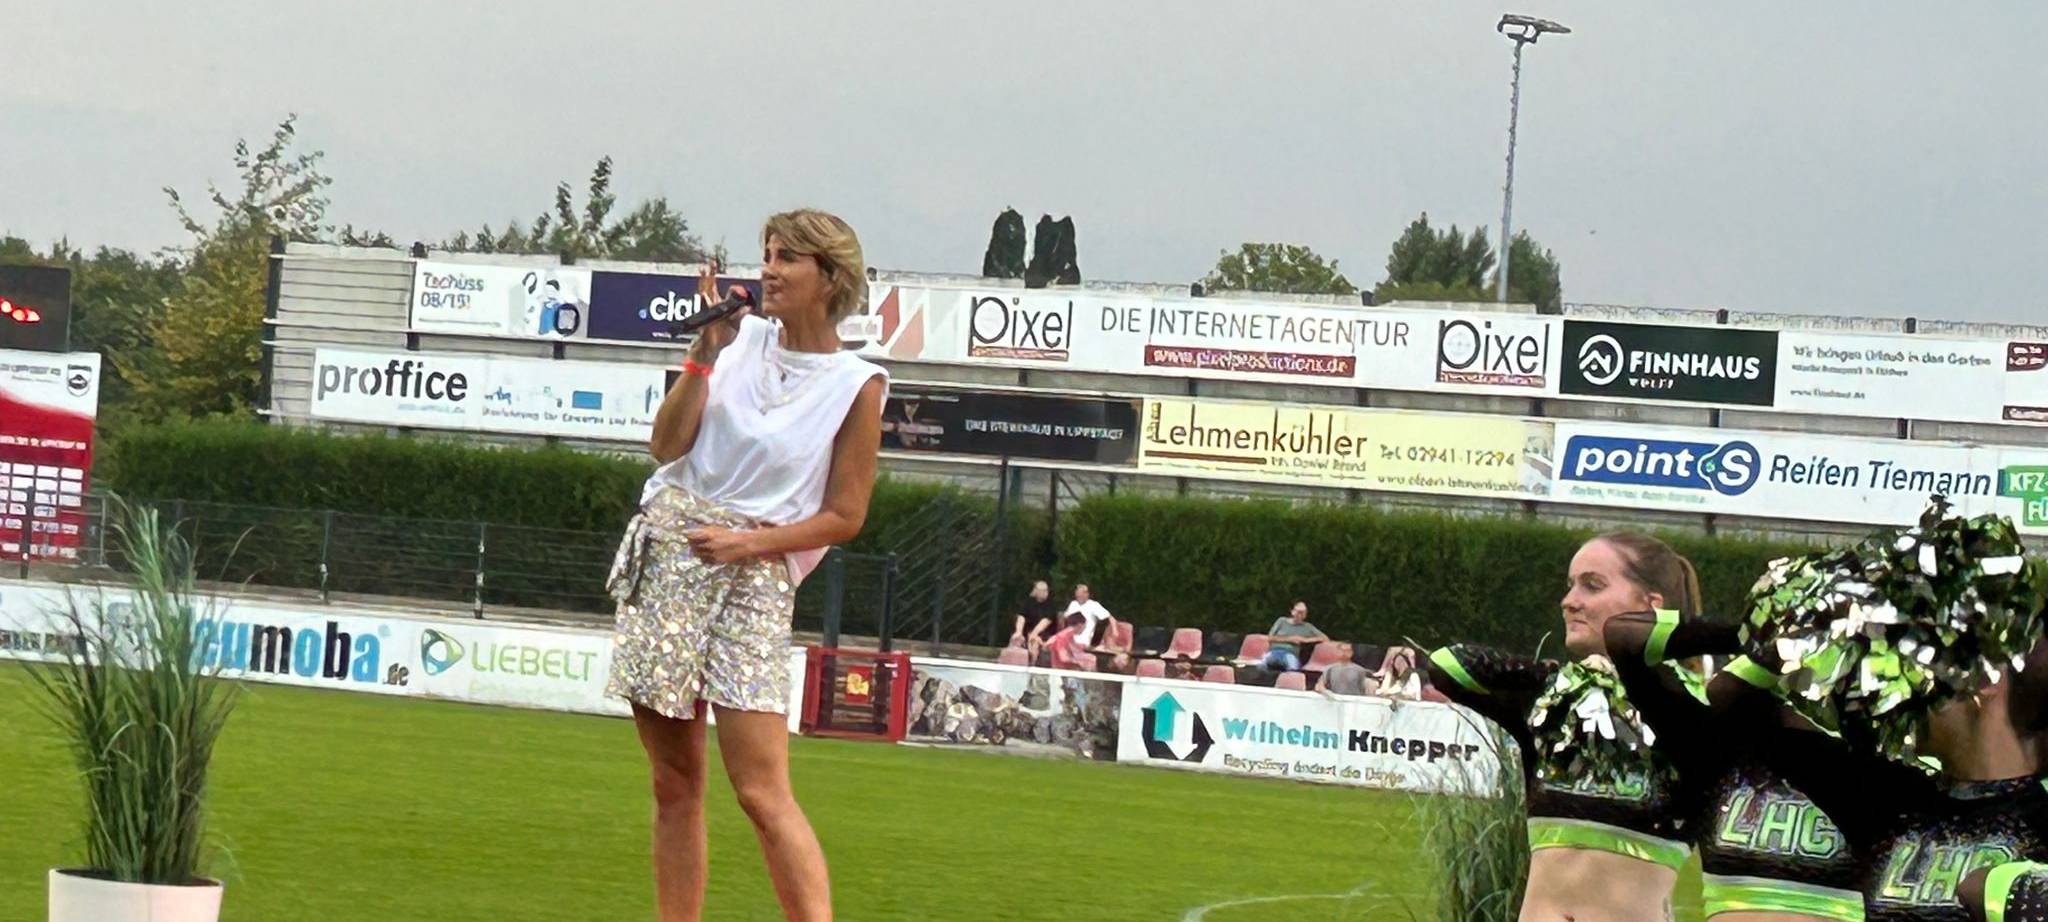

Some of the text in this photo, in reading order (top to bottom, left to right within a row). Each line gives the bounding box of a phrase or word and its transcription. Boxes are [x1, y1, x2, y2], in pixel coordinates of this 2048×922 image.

[1101, 307, 1410, 347] DIE INTERNETAGENTUR
[317, 359, 468, 401] proffice
[1629, 350, 1761, 380] FINNHAUS
[1153, 402, 1367, 457] Lehmenkühler
[1575, 443, 1753, 487] point S
[1769, 454, 1991, 496] Reifen Tiemann
[471, 642, 598, 681] LIEBELT
[1222, 718, 1480, 763] Wilhelm Knepper
